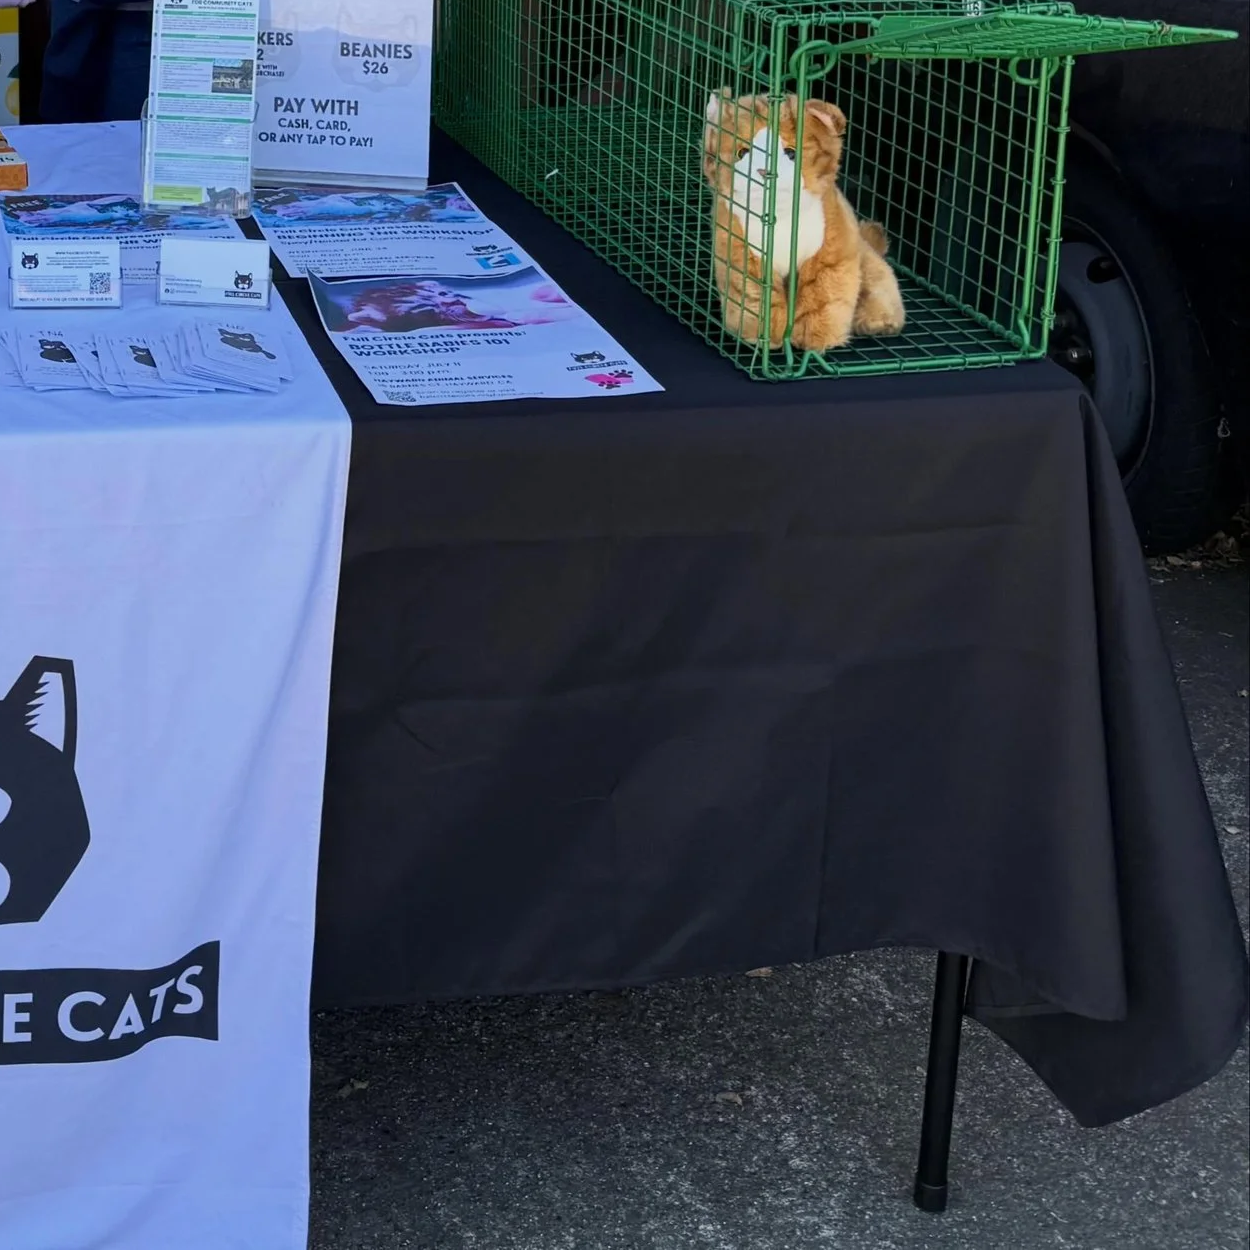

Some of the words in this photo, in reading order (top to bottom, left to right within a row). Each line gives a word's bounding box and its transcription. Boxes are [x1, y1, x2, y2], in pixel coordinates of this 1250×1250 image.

[339, 41, 413, 60] BEANIES
[362, 60, 389, 75] $26
[273, 96, 306, 114] PAY
[310, 98, 359, 117] WITH
[278, 118, 313, 131] CASH,
[316, 119, 351, 132] CARD,
[258, 132, 278, 143] OR
[279, 132, 304, 144] ANY
[306, 134, 326, 146] TAP
[329, 134, 347, 146] TO
[349, 135, 374, 148] PAY!
[417, 339, 481, 348] BABIES
[483, 338, 510, 346] 101
[353, 347, 461, 357] WORKSHOP
[56, 964, 205, 1042] CATS
